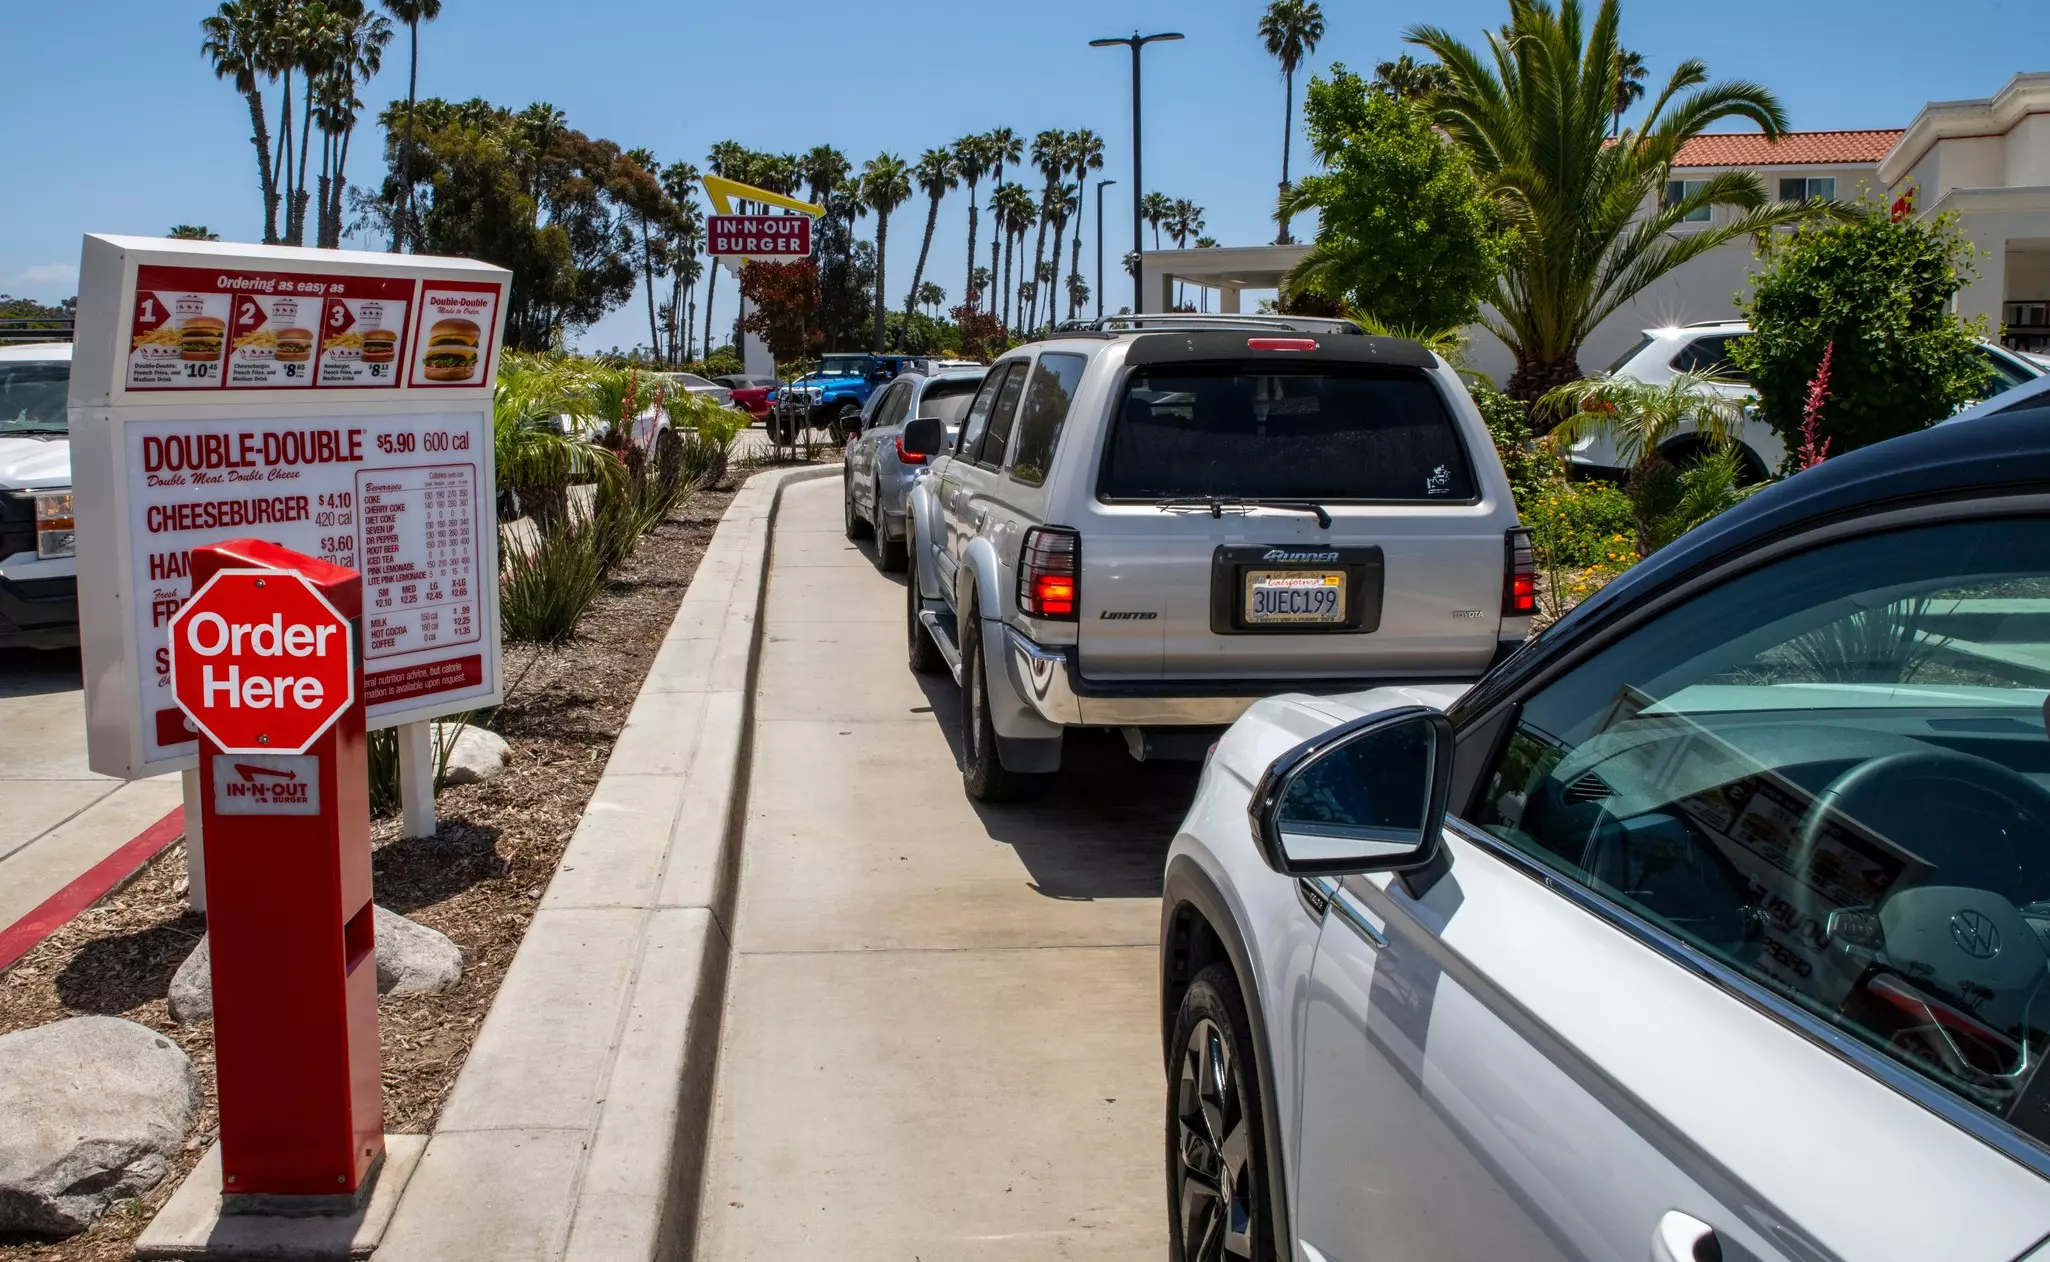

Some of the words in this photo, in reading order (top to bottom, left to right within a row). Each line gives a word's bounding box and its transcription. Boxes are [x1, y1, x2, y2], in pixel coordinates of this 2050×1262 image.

[718, 238, 800, 251] BURGER
[217, 275, 275, 292] Ordering
[278, 281, 293, 291] as
[297, 282, 327, 295] easy
[329, 283, 344, 293] as
[430, 296, 488, 308] Double-Double
[140, 299, 156, 323] 1
[239, 303, 255, 325] 2
[330, 306, 345, 327] 3
[437, 306, 456, 315] Made
[144, 429, 363, 473] DOUBLE-DOUBLE
[377, 432, 416, 454] $5.90
[424, 432, 449, 452] 600
[452, 431, 469, 450] cal
[147, 474, 186, 487] Double
[228, 470, 264, 483] Double
[268, 468, 300, 481] Cheese
[366, 482, 402, 493] Beverages
[364, 496, 381, 504] COKE
[147, 496, 309, 533] CHEESEBURGER
[365, 505, 389, 514] CHERRY
[390, 504, 405, 512] COKE
[316, 512, 335, 527] 420
[338, 511, 352, 526] cal
[366, 516, 380, 525] DIET
[380, 515, 396, 523] COKE
[366, 526, 386, 535] SEVEN
[386, 525, 395, 533] UP
[321, 536, 353, 552] $3.60
[366, 537, 375, 545] DR
[376, 535, 399, 544] PEPPER
[367, 546, 383, 555] ROOT
[384, 545, 399, 554] BEER
[340, 553, 354, 568] cal
[368, 557, 381, 566] ICED
[382, 556, 394, 564] TEA
[368, 566, 382, 575] PINK
[383, 563, 414, 574] LEMONADE
[368, 577, 380, 586] LITE
[381, 575, 395, 584] PINK
[396, 571, 427, 583] LEMONADE
[430, 570, 434, 578] 5
[1268, 578, 1321, 588] California
[153, 588, 177, 600] Fresh
[378, 588, 389, 597] SM
[402, 585, 416, 594] MED
[430, 582, 438, 590] LG
[452, 578, 466, 587] X-LG
[376, 598, 392, 608] $2.10
[401, 595, 417, 604] $2.25
[426, 591, 443, 601] $2.45
[452, 588, 468, 597] $2.65
[1254, 590, 1337, 614] 3UEC199
[370, 618, 387, 628] MILK
[1100, 610, 1157, 620] LIMITED
[1452, 611, 1484, 619] TOYOTA
[187, 612, 337, 657] Order
[371, 630, 384, 639] HOT
[386, 626, 408, 637] COCOA
[431, 622, 439, 630] cal
[454, 616, 471, 626] $2.25
[372, 638, 396, 650] COFFEE
[428, 632, 436, 641] cal
[364, 677, 377, 688] eral
[378, 672, 405, 685] nutrition
[406, 668, 429, 679] advice,
[430, 667, 441, 676] but
[441, 663, 462, 673] calorie
[202, 665, 324, 709] Here
[364, 688, 388, 699] rmation
[388, 686, 395, 695] is
[396, 680, 424, 693] available
[424, 678, 441, 689] upon
[442, 672, 466, 686] request.
